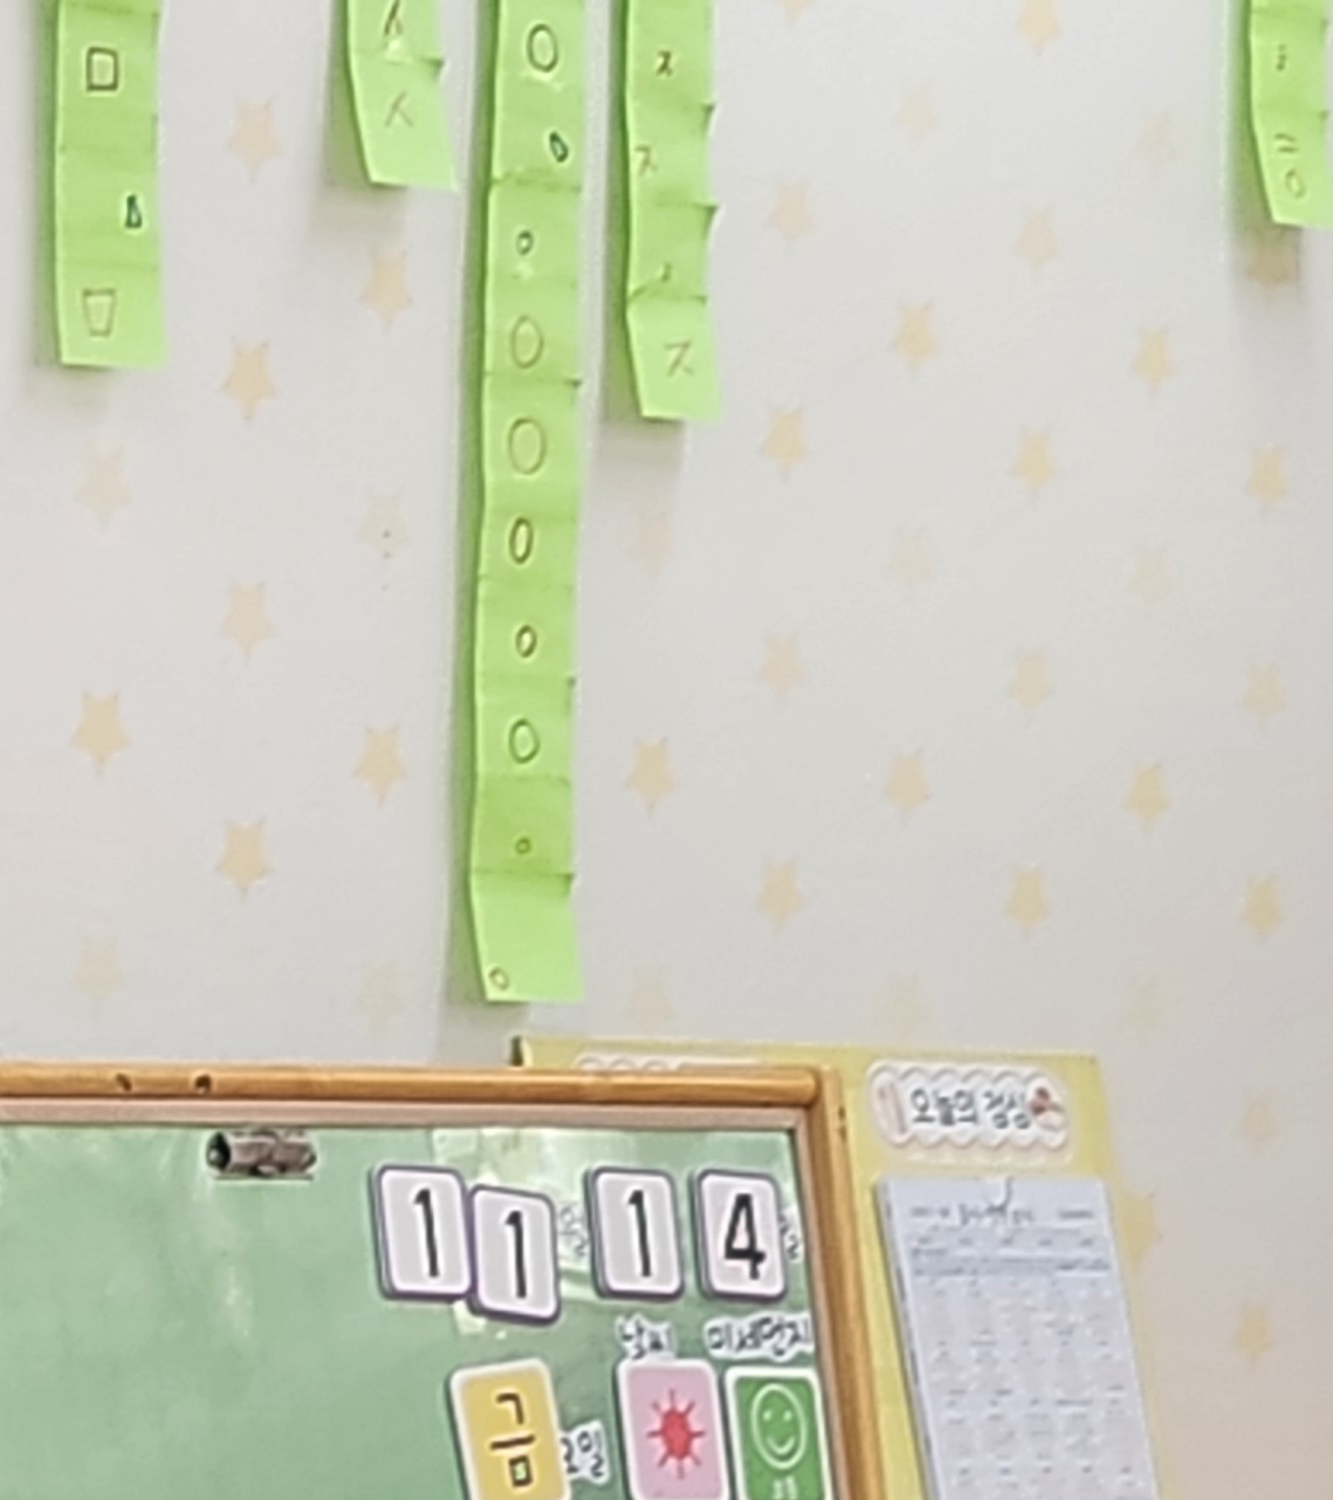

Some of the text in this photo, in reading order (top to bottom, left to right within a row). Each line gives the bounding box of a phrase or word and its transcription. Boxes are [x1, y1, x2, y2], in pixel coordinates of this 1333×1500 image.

[910, 1088, 979, 1127] 오늘의
[706, 1317, 812, 1357] 미세먼지
[490, 1393, 536, 1487] 금
